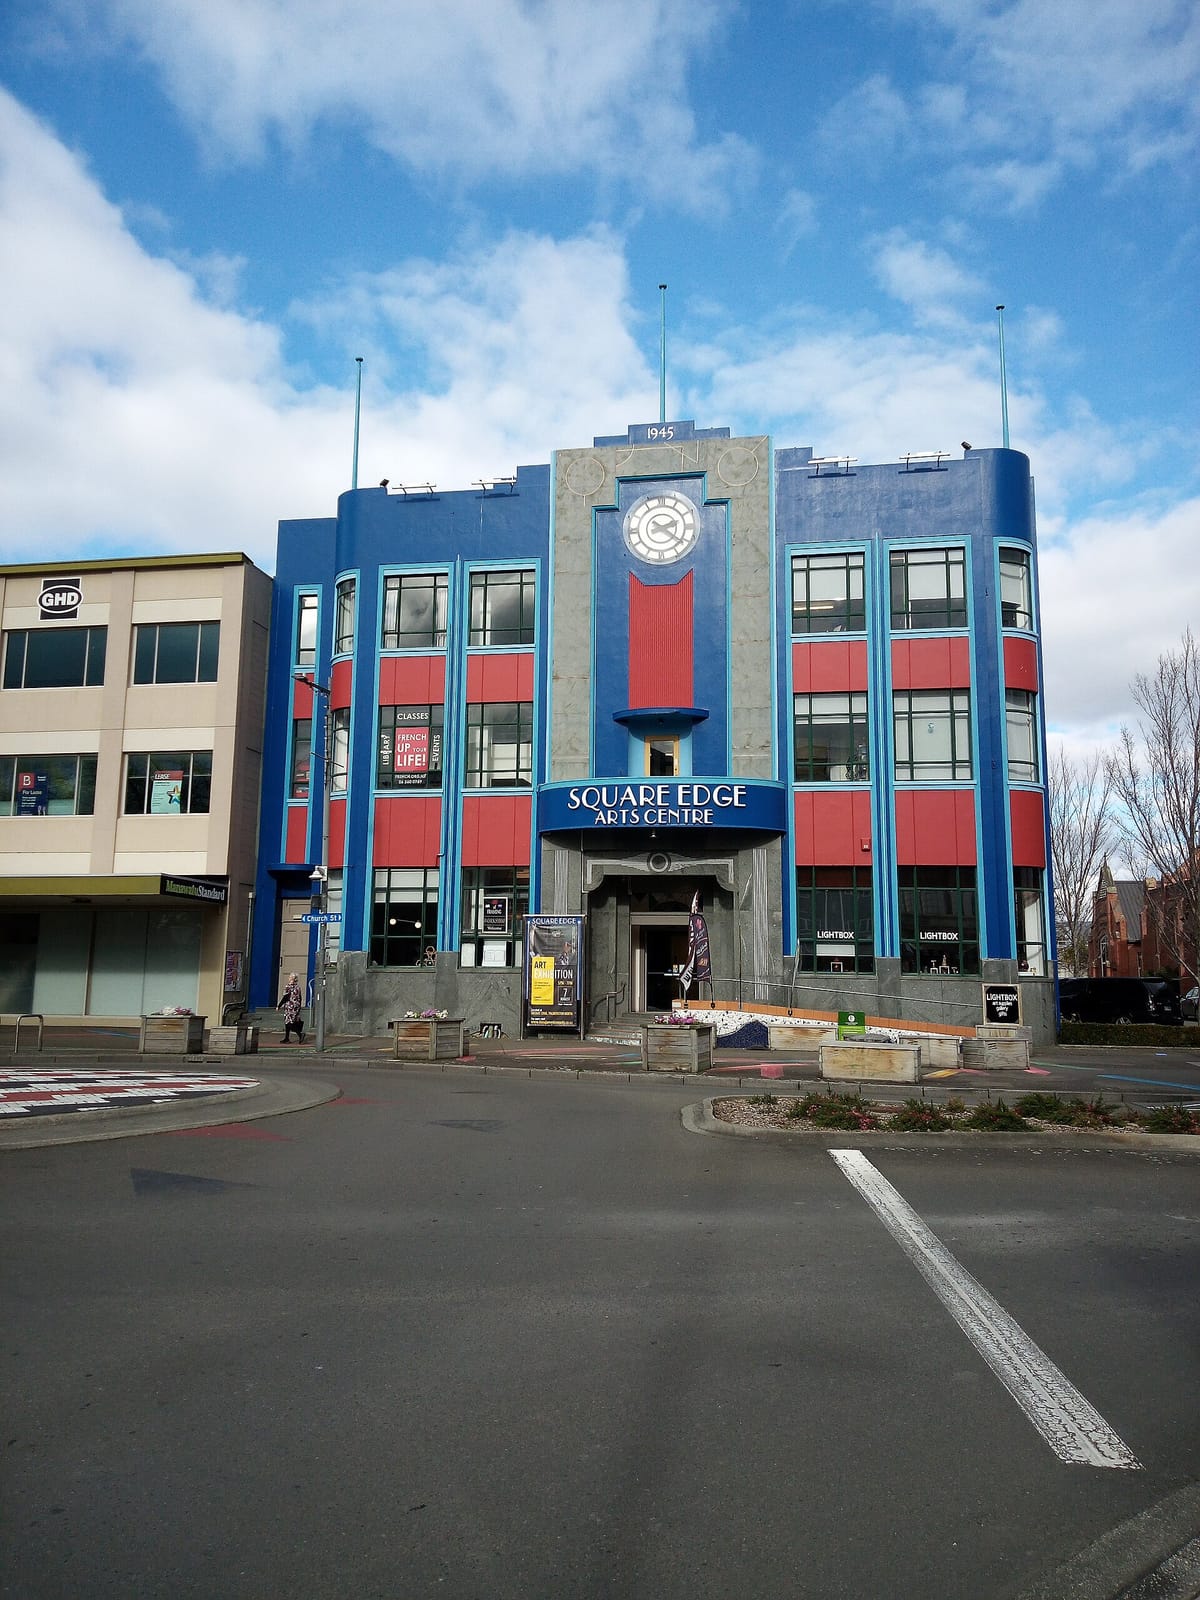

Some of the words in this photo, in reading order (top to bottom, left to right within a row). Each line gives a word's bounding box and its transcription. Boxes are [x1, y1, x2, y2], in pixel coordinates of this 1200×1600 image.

[647, 426, 674, 440] 1945
[41, 592, 79, 607] GHD
[397, 712, 429, 720] CLASSES
[383, 735, 391, 766] LIBRARY
[397, 743, 411, 753] UP
[432, 734, 440, 762] EVENTS
[397, 754, 426, 767] LIFE!
[23, 775, 31, 786] B
[567, 785, 670, 811] SQUARE
[677, 785, 747, 807] EDGE
[594, 809, 640, 825] ARTS
[643, 809, 714, 825] CENTRE
[306, 914, 328, 922] Church
[329, 914, 338, 922] St
[817, 931, 854, 939] LIGHTBOX
[920, 932, 959, 940] LIGHTBOX
[534, 970, 573, 979] EXHIBITION
[986, 993, 1017, 1001] LIGHTBOX
